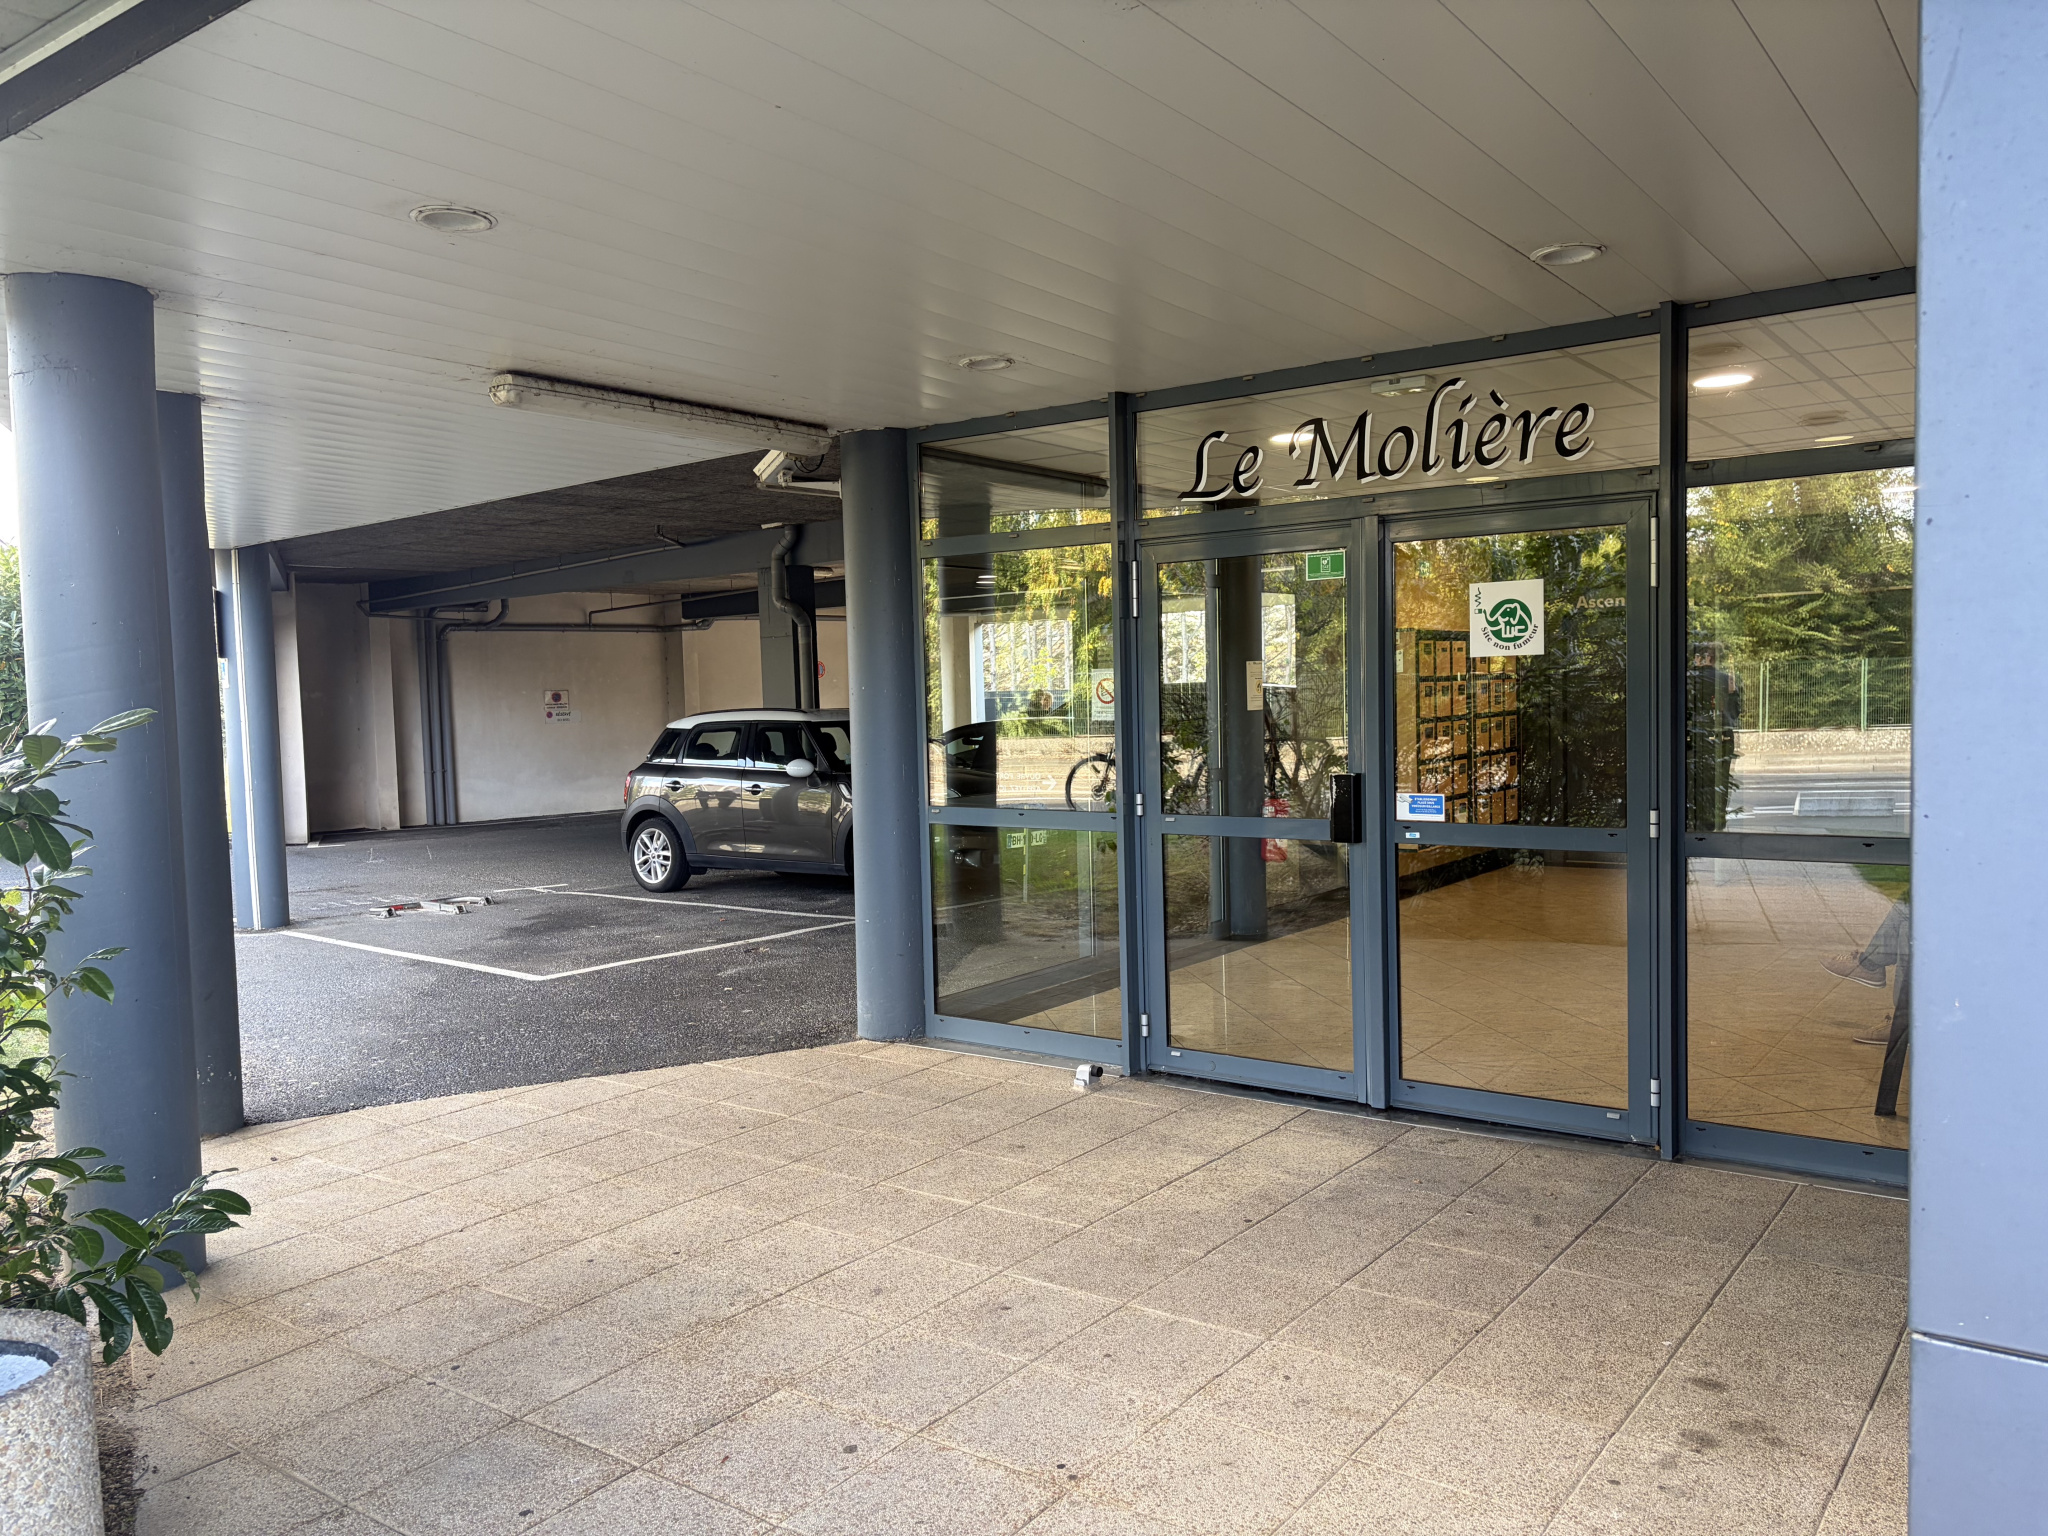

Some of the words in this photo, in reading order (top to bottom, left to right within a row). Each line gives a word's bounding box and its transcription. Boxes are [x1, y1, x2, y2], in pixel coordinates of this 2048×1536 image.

[1178, 430, 1264, 502] Le
[1288, 377, 1595, 489] Molière
[1481, 626, 1493, 642] Site
[1493, 642, 1510, 650] non
[1513, 624, 1538, 650] fumeur
